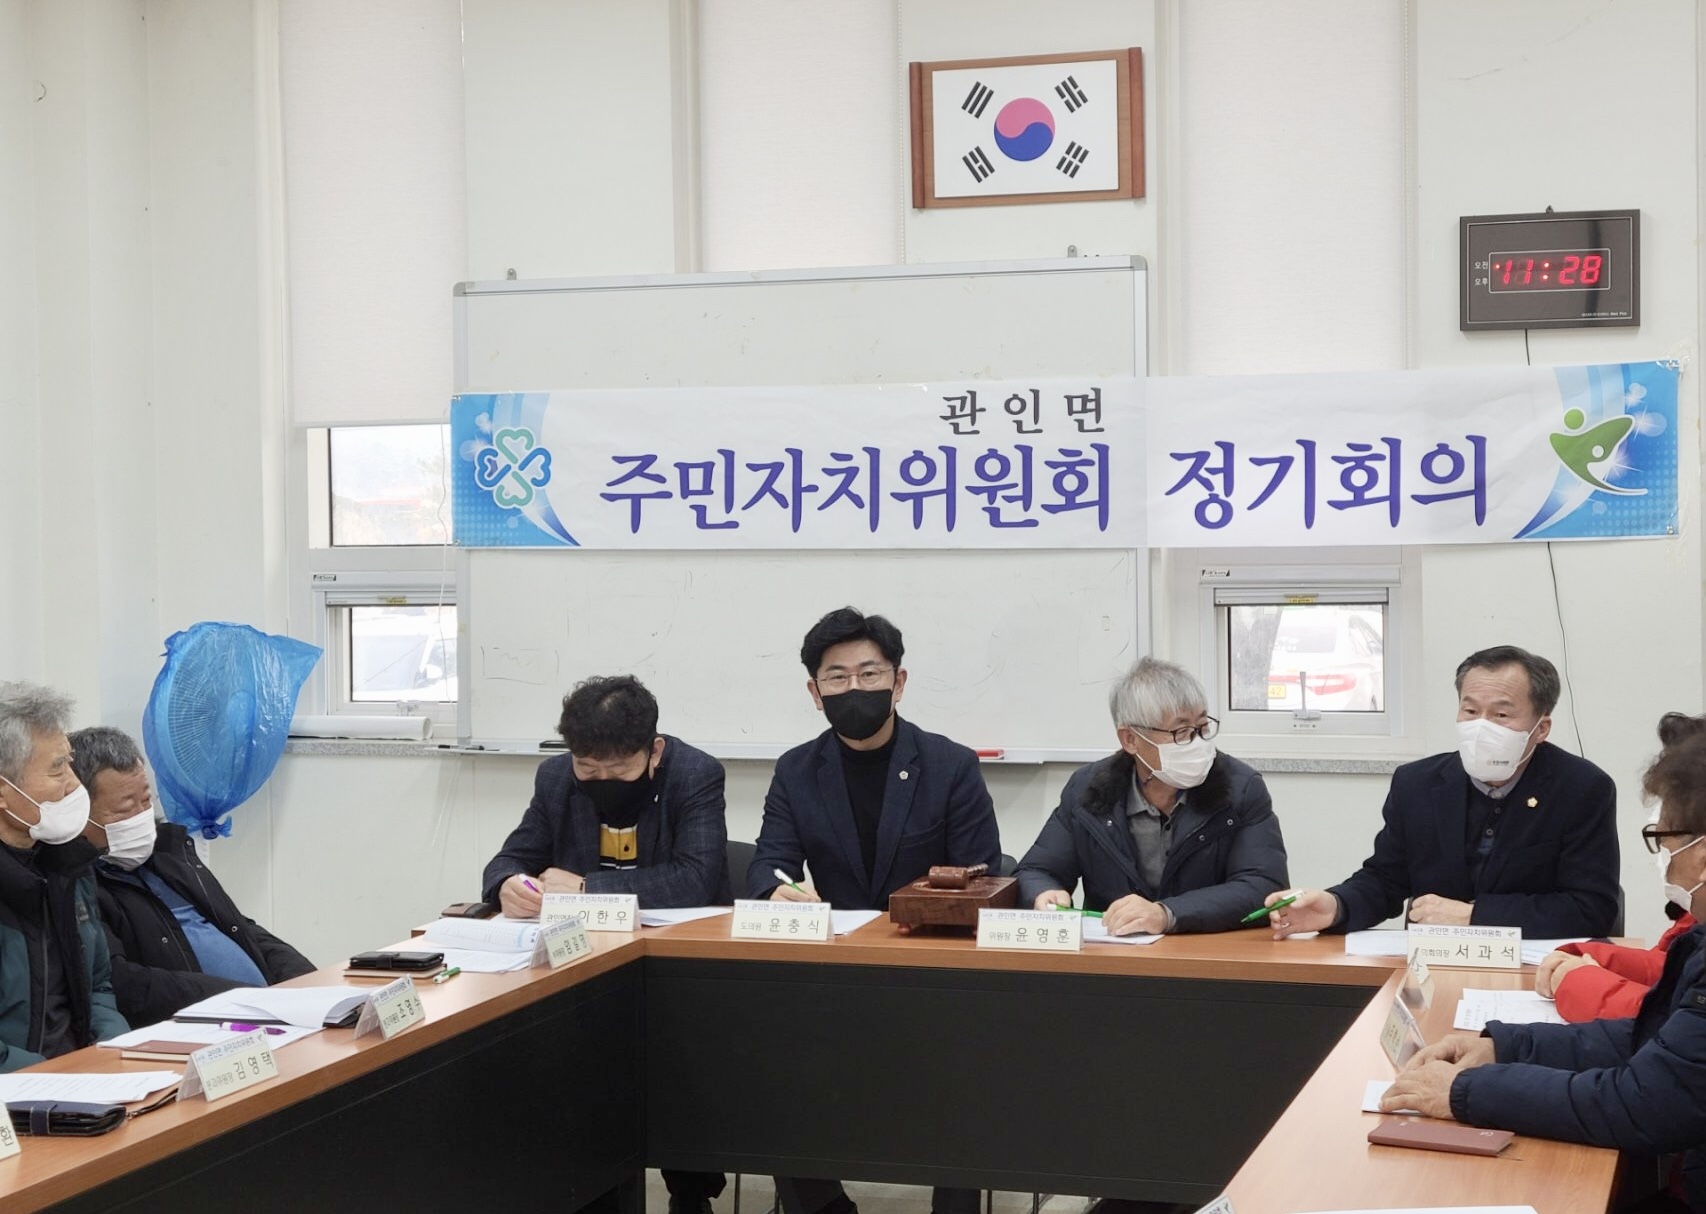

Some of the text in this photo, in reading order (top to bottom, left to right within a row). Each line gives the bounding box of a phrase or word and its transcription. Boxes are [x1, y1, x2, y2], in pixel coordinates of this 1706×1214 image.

[1503, 255, 1602, 285] 11:28
[602, 435, 1485, 532] 주민자치위원회 정기회의
[740, 921, 762, 932] 도의원
[1453, 928, 1502, 938] 주민자치위원회
